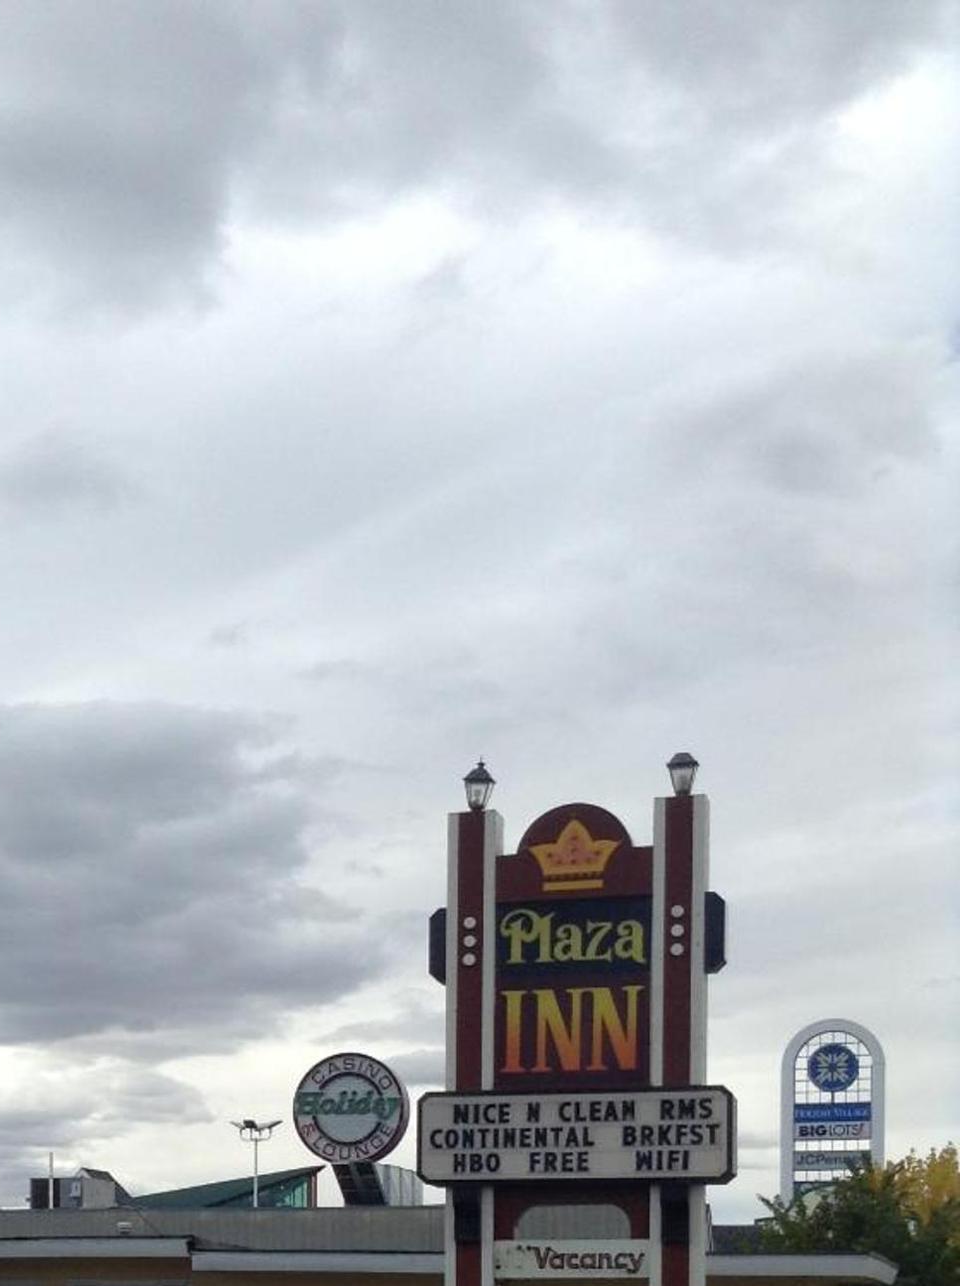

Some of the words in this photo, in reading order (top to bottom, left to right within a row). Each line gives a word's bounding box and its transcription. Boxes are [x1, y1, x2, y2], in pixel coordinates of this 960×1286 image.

[500, 908, 647, 965] Plaza
[500, 984, 644, 1073] INN
[312, 1058, 393, 1090] CASINO
[453, 1103, 510, 1125] NICE
[527, 1102, 540, 1123] N
[558, 1100, 636, 1123] CLEAN
[659, 1099, 713, 1120] RMS
[314, 1122, 393, 1160] LOUNGE
[429, 1126, 595, 1149] CONTINENTAL
[621, 1123, 720, 1147] BRKFST
[799, 1125, 827, 1137] BIG
[453, 1153, 501, 1174] HBO
[529, 1151, 590, 1173] FREE
[635, 1150, 689, 1172] WIFI
[527, 1245, 645, 1274] Vacancy
